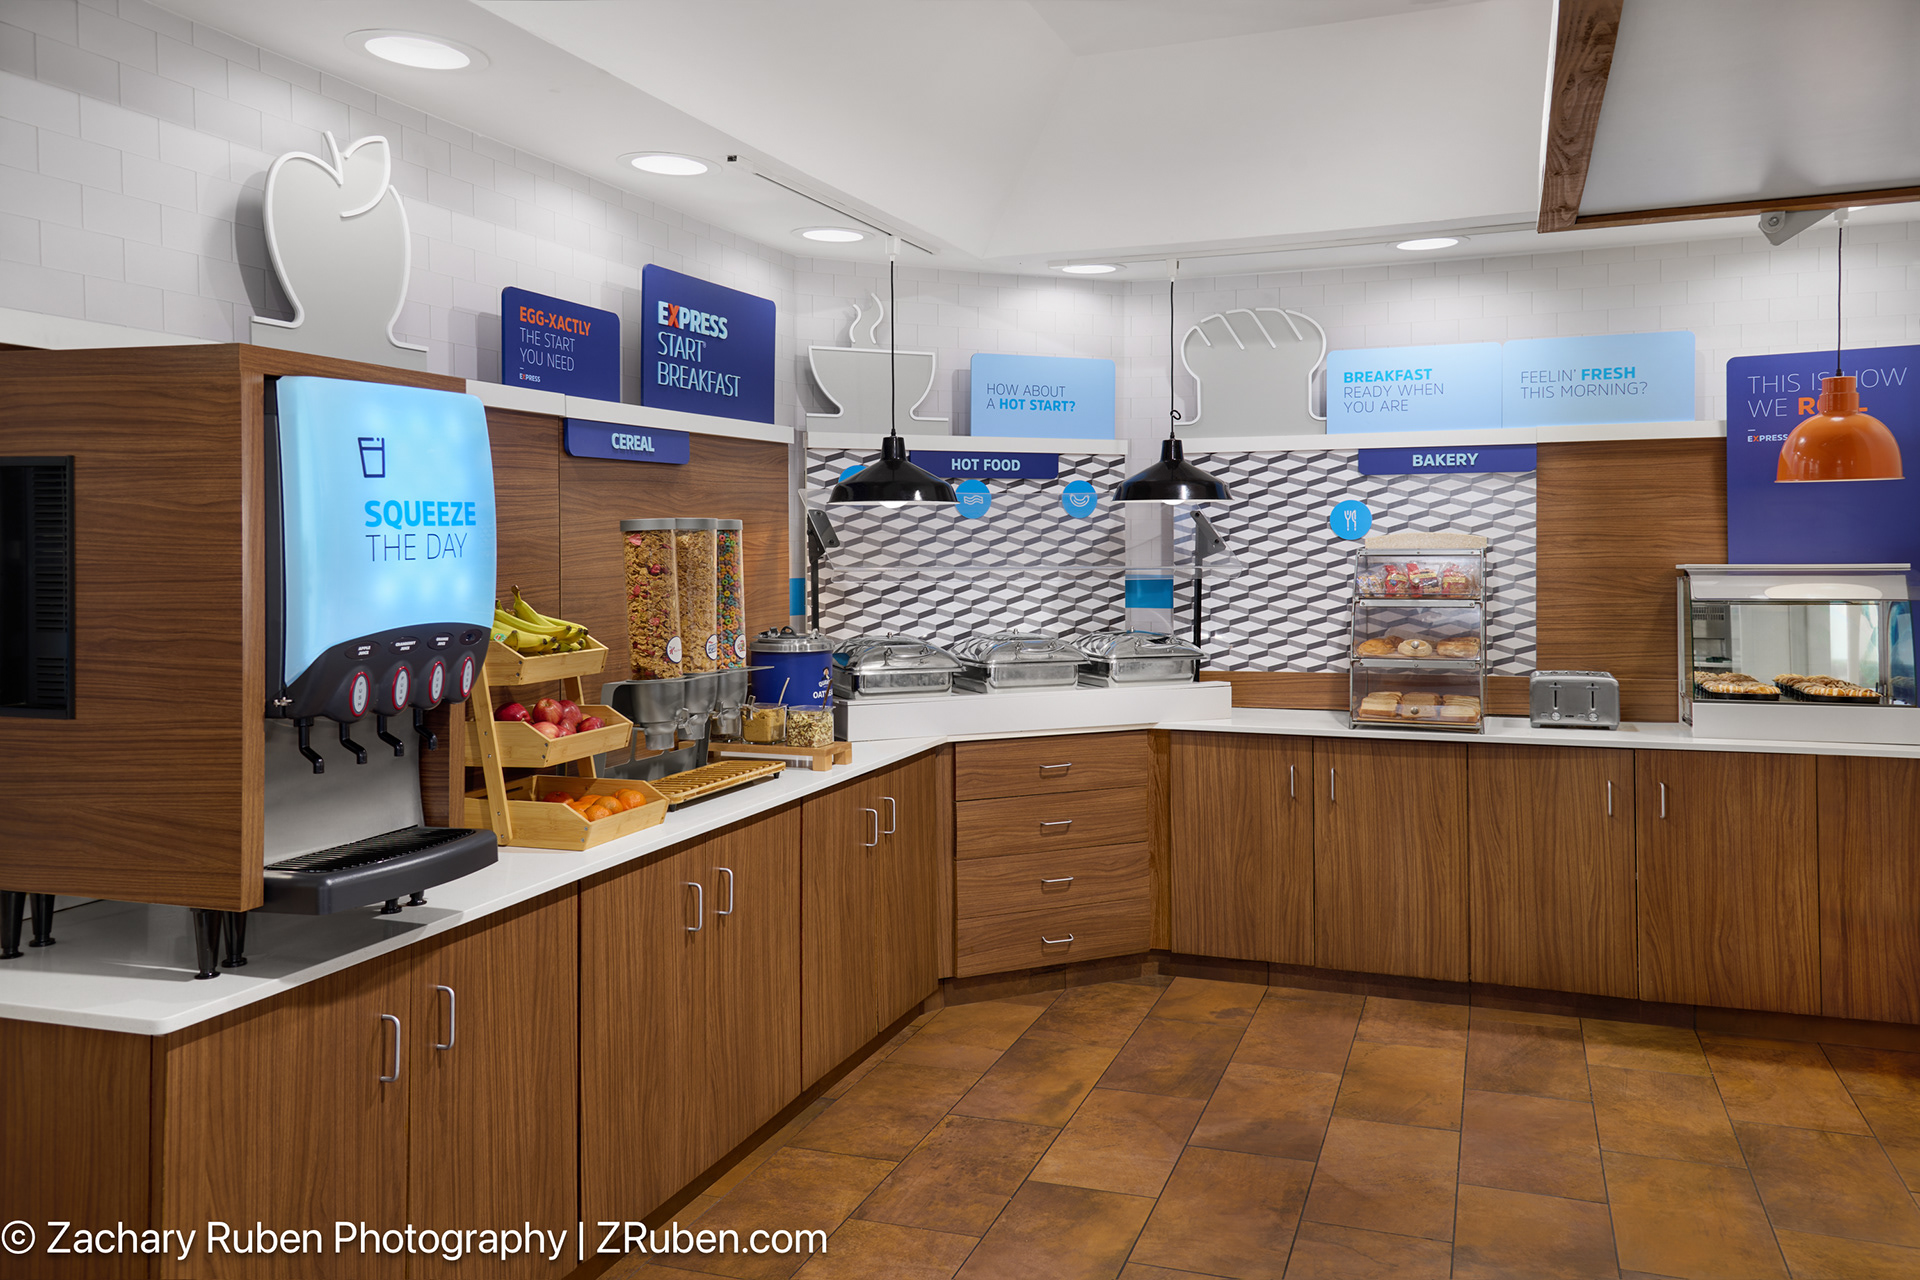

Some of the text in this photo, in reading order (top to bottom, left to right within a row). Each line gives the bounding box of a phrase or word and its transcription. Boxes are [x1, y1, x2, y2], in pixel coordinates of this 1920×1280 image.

[519, 306, 591, 336] EGG-XACTLY
[658, 300, 728, 340] EXPRESS
[520, 327, 576, 352] THE START
[520, 348, 575, 372] YOU NEED
[519, 372, 541, 382] EXPRESS
[658, 361, 741, 398] BREAKFAST
[1344, 368, 1433, 384] BREAKFAST
[1581, 366, 1636, 382] FRESH
[1748, 373, 1801, 394] THIS
[986, 382, 1066, 398] HOW ABOUT
[1344, 382, 1444, 399] READY WHEN
[1521, 381, 1648, 400] THIS MORNING?
[986, 397, 1076, 412] A HOT START?
[1344, 398, 1409, 414] YOU ARE
[1748, 398, 1788, 418] WE
[611, 432, 655, 452] CEREAL
[1748, 434, 1788, 442] EXPRESS
[951, 458, 1021, 472] HOT FOOD
[1412, 452, 1478, 468] BAKERY
[364, 500, 476, 530] SQUEEZE
[366, 532, 468, 562] THE DAY
